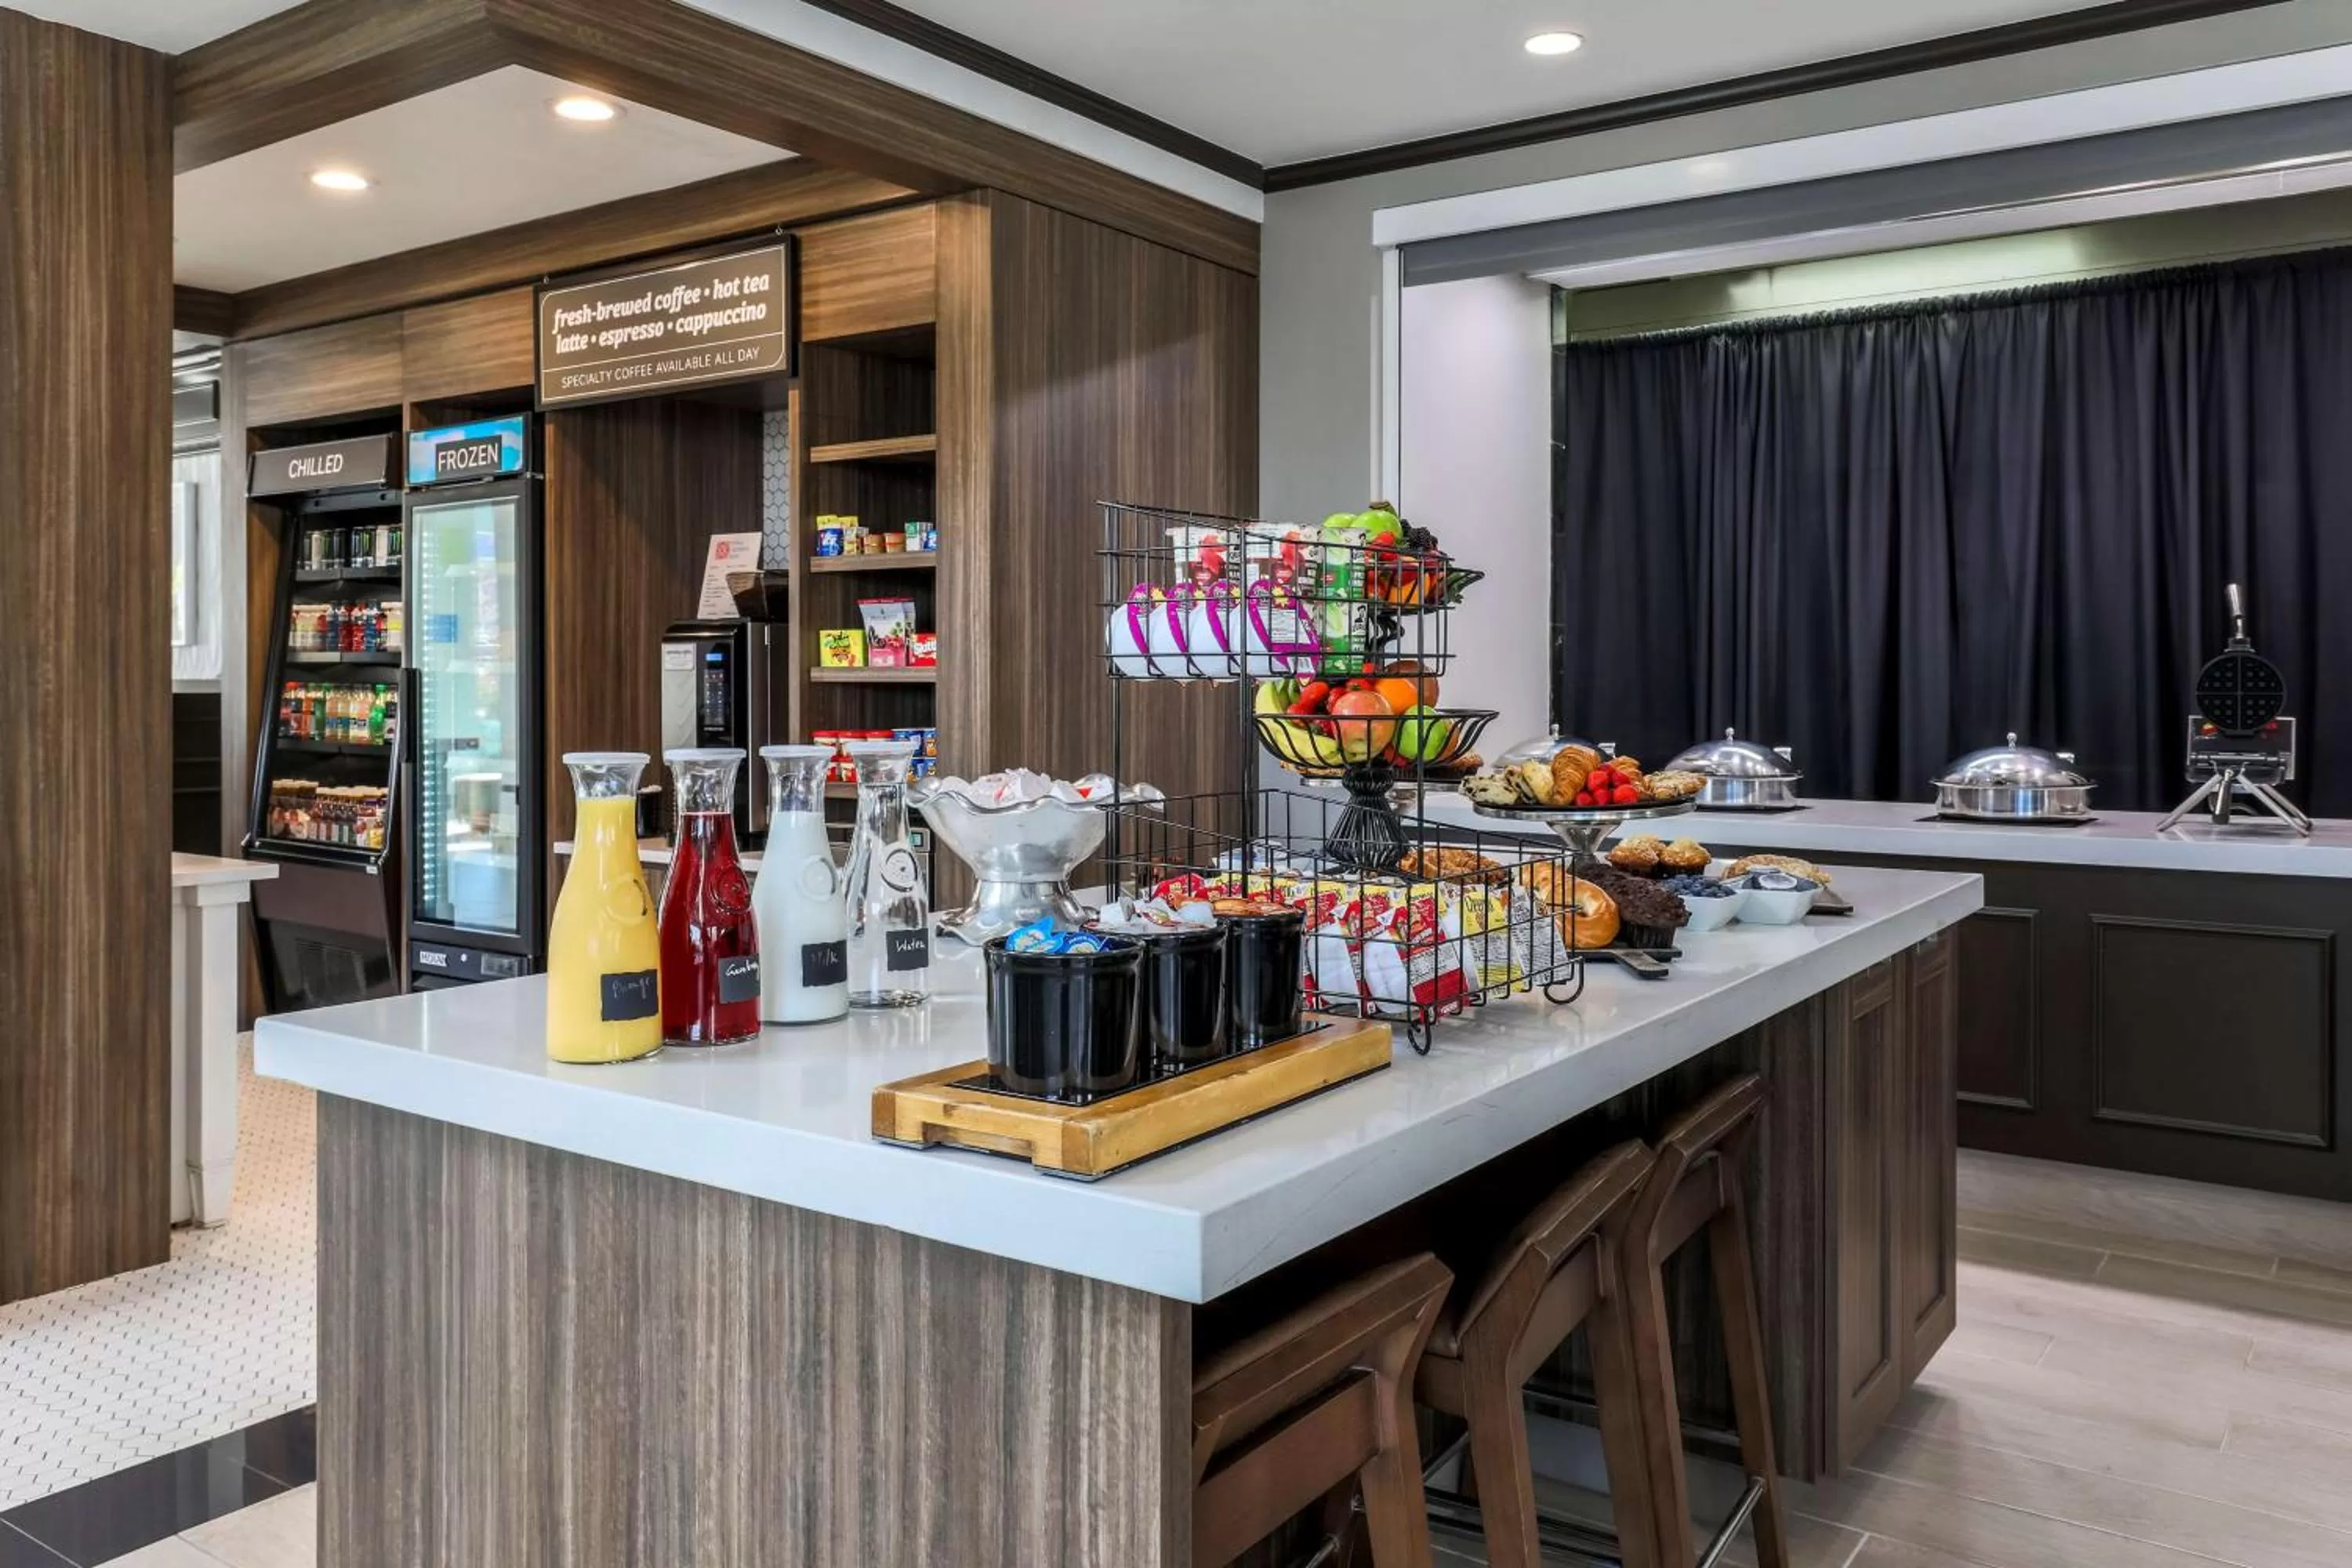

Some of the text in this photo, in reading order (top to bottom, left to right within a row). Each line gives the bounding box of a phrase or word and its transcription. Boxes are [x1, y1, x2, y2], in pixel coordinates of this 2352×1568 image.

[552, 273, 770, 334] fresh-brewed coffee hot tea
[555, 301, 767, 354] latte espresso cappuccino
[561, 346, 760, 389] SPECIALTY COFFEE AVAILABLE ALL DAY
[288, 453, 343, 479] CHILLED
[437, 442, 499, 472] FROZEN
